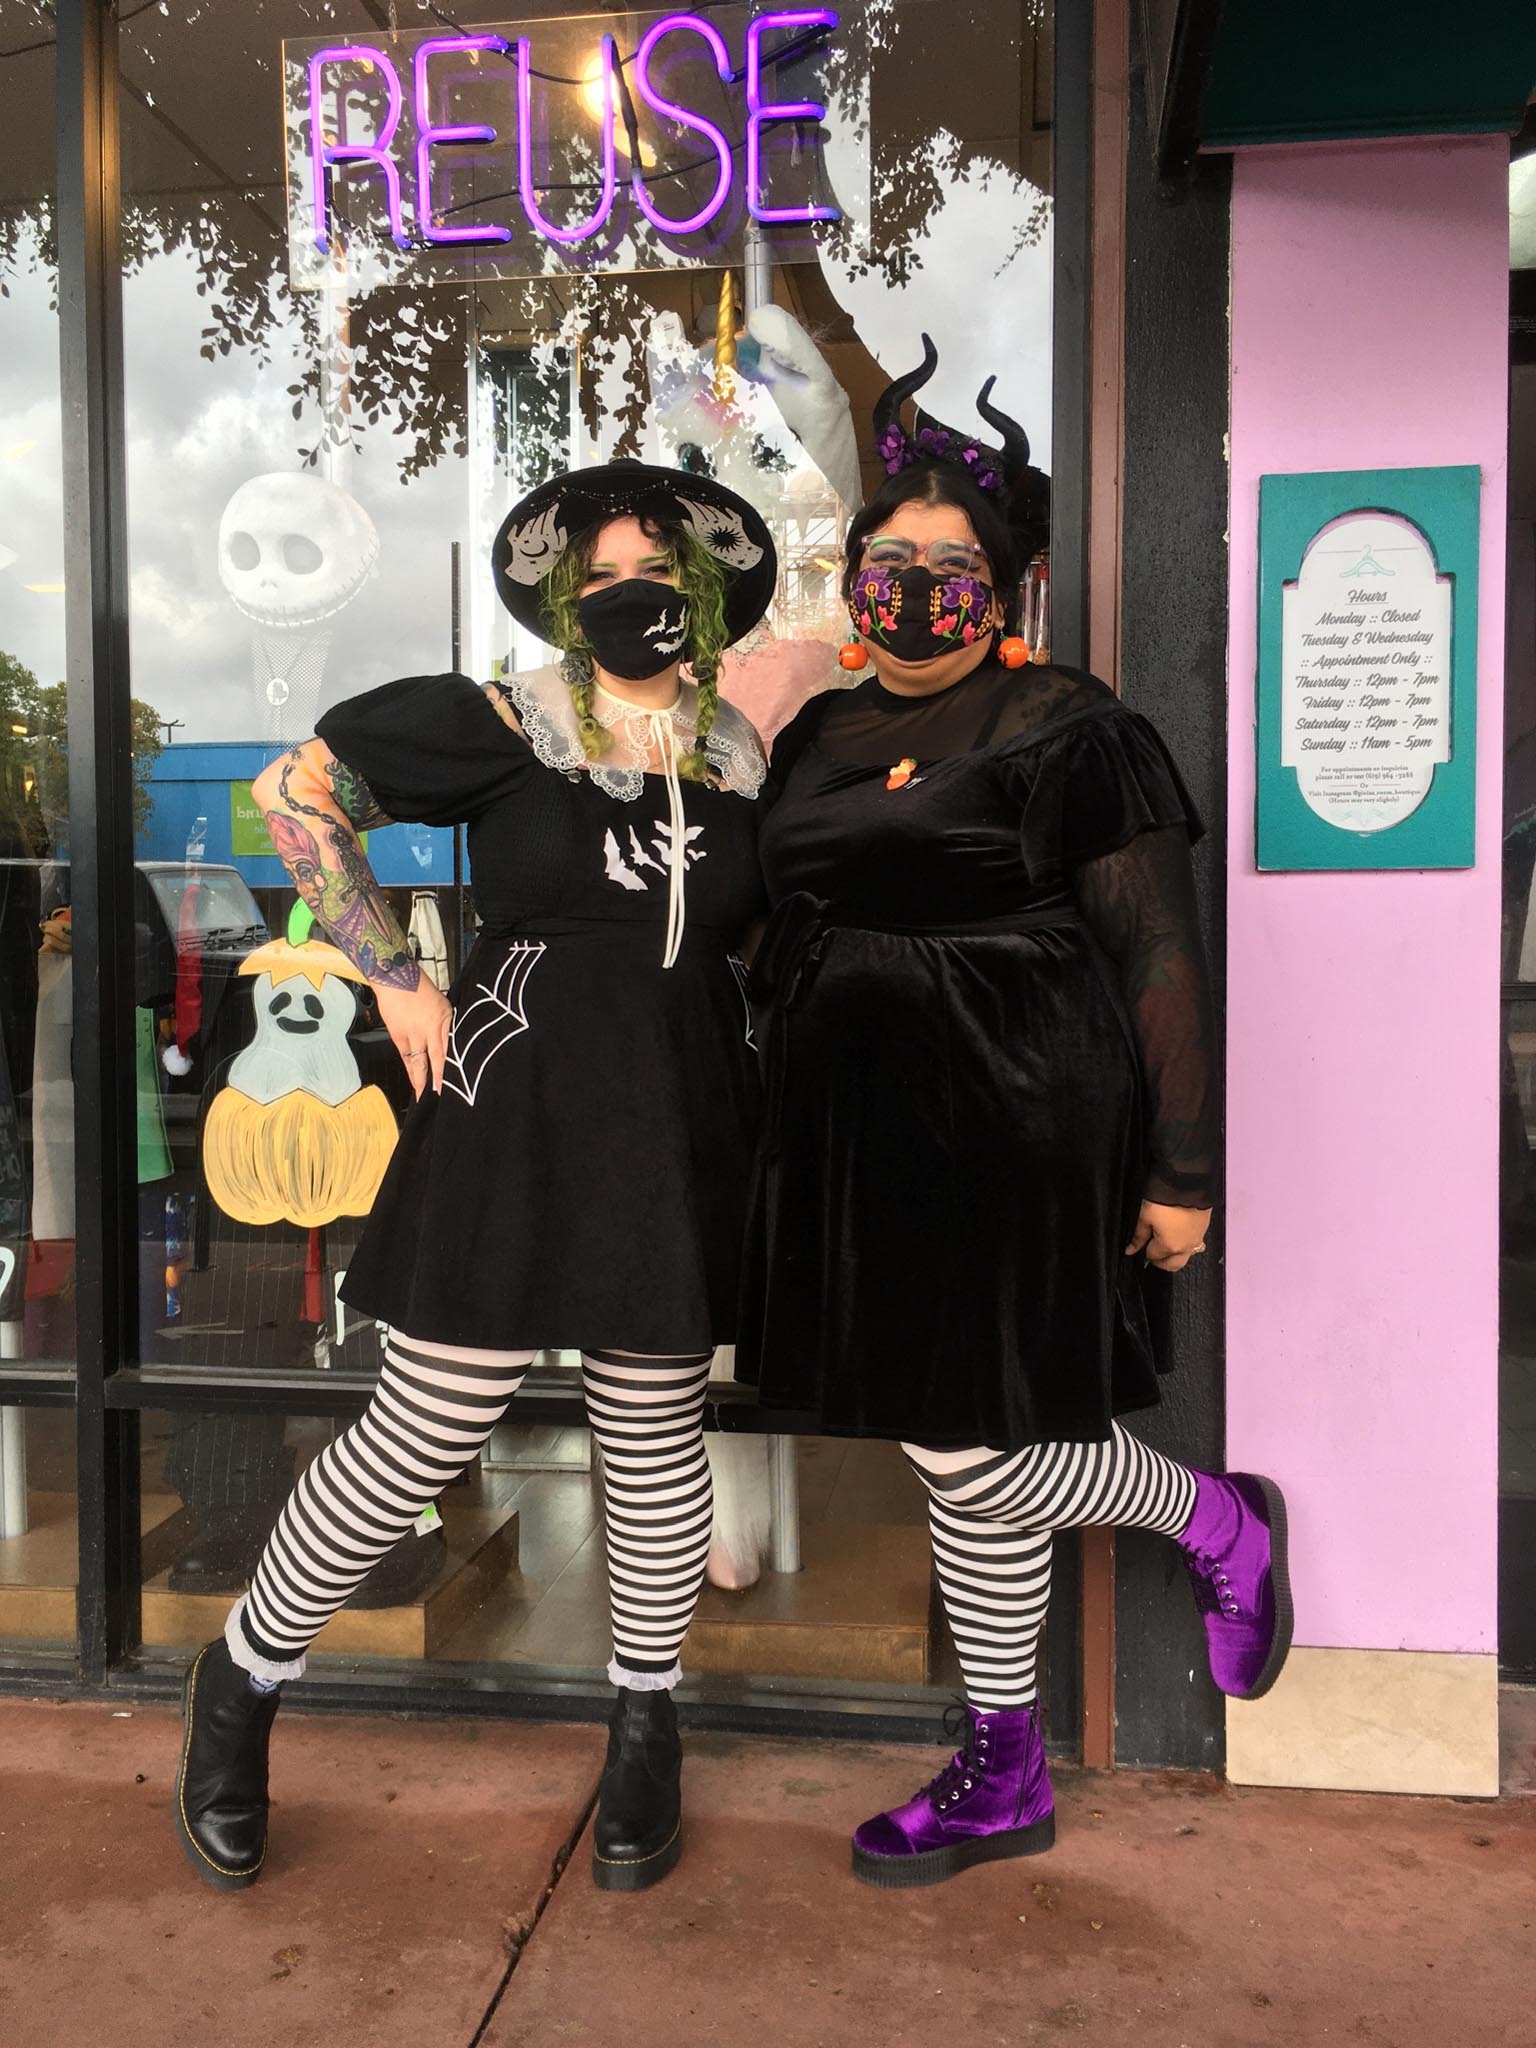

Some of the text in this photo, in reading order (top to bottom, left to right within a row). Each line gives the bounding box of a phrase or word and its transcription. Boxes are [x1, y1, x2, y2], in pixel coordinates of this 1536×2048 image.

[309, 9, 839, 254] REUSE
[1348, 589, 1388, 603] Hours
[1315, 612, 1366, 627] Monday
[1381, 609, 1421, 623] Closed
[1301, 630, 1434, 648] Tuesday & Wednesday
[1312, 653, 1390, 669] Appointment
[1391, 651, 1421, 666] Only
[1295, 675, 1351, 690] Thursday
[1366, 673, 1399, 689] 12pm
[1412, 672, 1439, 688] 7pm
[1302, 696, 1344, 711] Friday
[1358, 694, 1391, 709] 12pm
[1405, 693, 1432, 709] 7pm
[1295, 717, 1351, 732] Saturday
[1365, 715, 1398, 731] 12pm
[1412, 714, 1439, 729] 7pm
[1300, 737, 1346, 752] Sunday
[1361, 736, 1391, 749] 11am
[1404, 735, 1433, 751] 5pm
[1332, 766, 1372, 774] appointments
[1365, 772, 1381, 780] (619)
